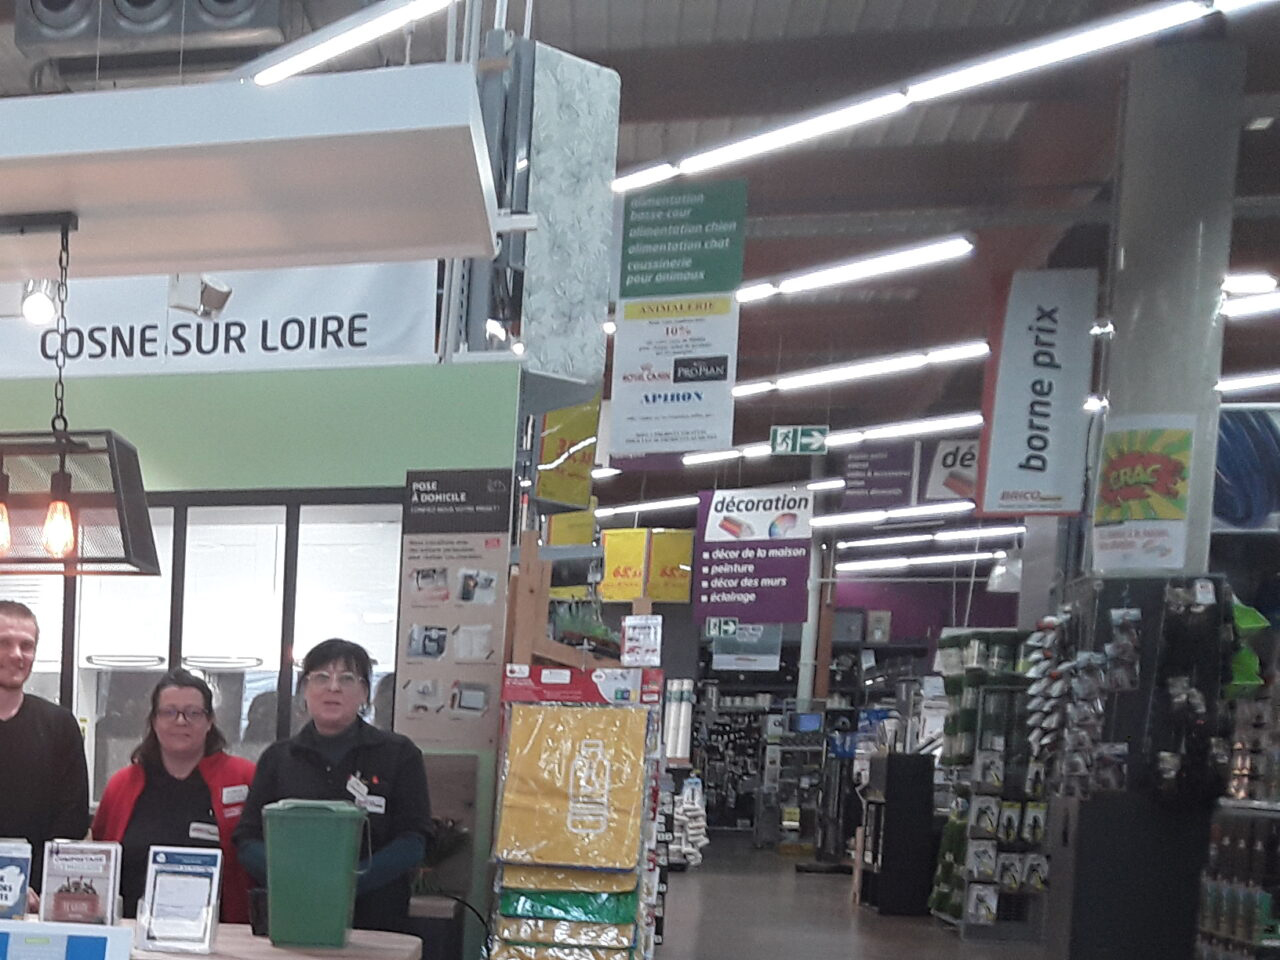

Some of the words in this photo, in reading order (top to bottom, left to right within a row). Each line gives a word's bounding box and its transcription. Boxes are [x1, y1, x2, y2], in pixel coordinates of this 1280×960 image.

[666, 208, 692, 218] cour
[629, 223, 703, 237] alimentation
[705, 221, 737, 232] chien
[628, 240, 702, 254] alimentation
[705, 238, 730, 249] chat
[626, 275, 653, 286] pour
[655, 270, 705, 283] animaux
[40, 324, 159, 360] COSNE
[172, 321, 247, 355] SUR
[260, 313, 369, 351] LOIRE
[1029, 305, 1061, 369] prix
[1018, 379, 1053, 473] borne
[412, 481, 437, 491] POSE
[421, 492, 466, 502] DOMICILE
[714, 494, 809, 513] décoration
[712, 547, 740, 560] décor
[742, 547, 755, 558] de
[756, 547, 766, 558] la
[768, 547, 806, 557] maison
[710, 563, 754, 575] peinture
[711, 577, 738, 588] décor
[740, 576, 759, 587] des
[761, 576, 787, 586] murs
[710, 591, 756, 603] éclairage
